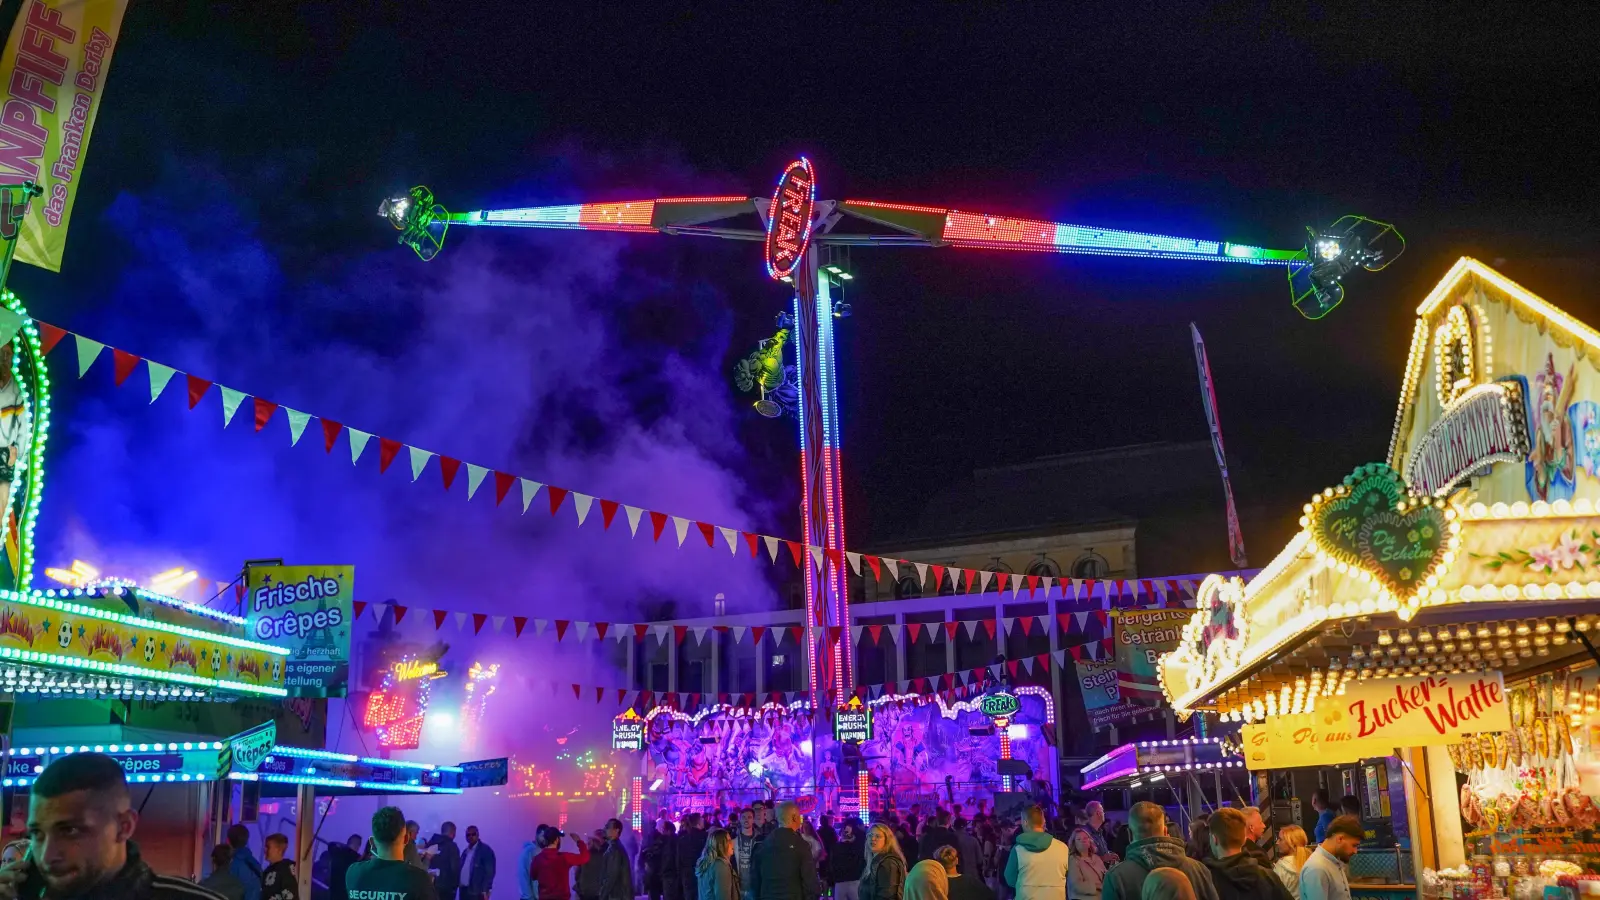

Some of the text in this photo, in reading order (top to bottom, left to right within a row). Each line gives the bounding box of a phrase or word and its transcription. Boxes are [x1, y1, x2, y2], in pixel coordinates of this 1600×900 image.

[43, 26, 112, 227] das Franken Derby
[775, 175, 811, 262] FREAK
[1373, 529, 1397, 546] Du
[1381, 544, 1433, 562] Schelm
[255, 575, 339, 611] Frische
[256, 607, 341, 640] Crêpes
[306, 646, 341, 656] herzhaft
[296, 664, 337, 675] eigener
[983, 695, 1015, 711] FREAK
[1424, 679, 1503, 735] Watte
[839, 714, 866, 722] ENERGY
[843, 722, 862, 730] RUSH
[236, 740, 271, 766] Crêpes
[349, 889, 408, 900] SECURITY
